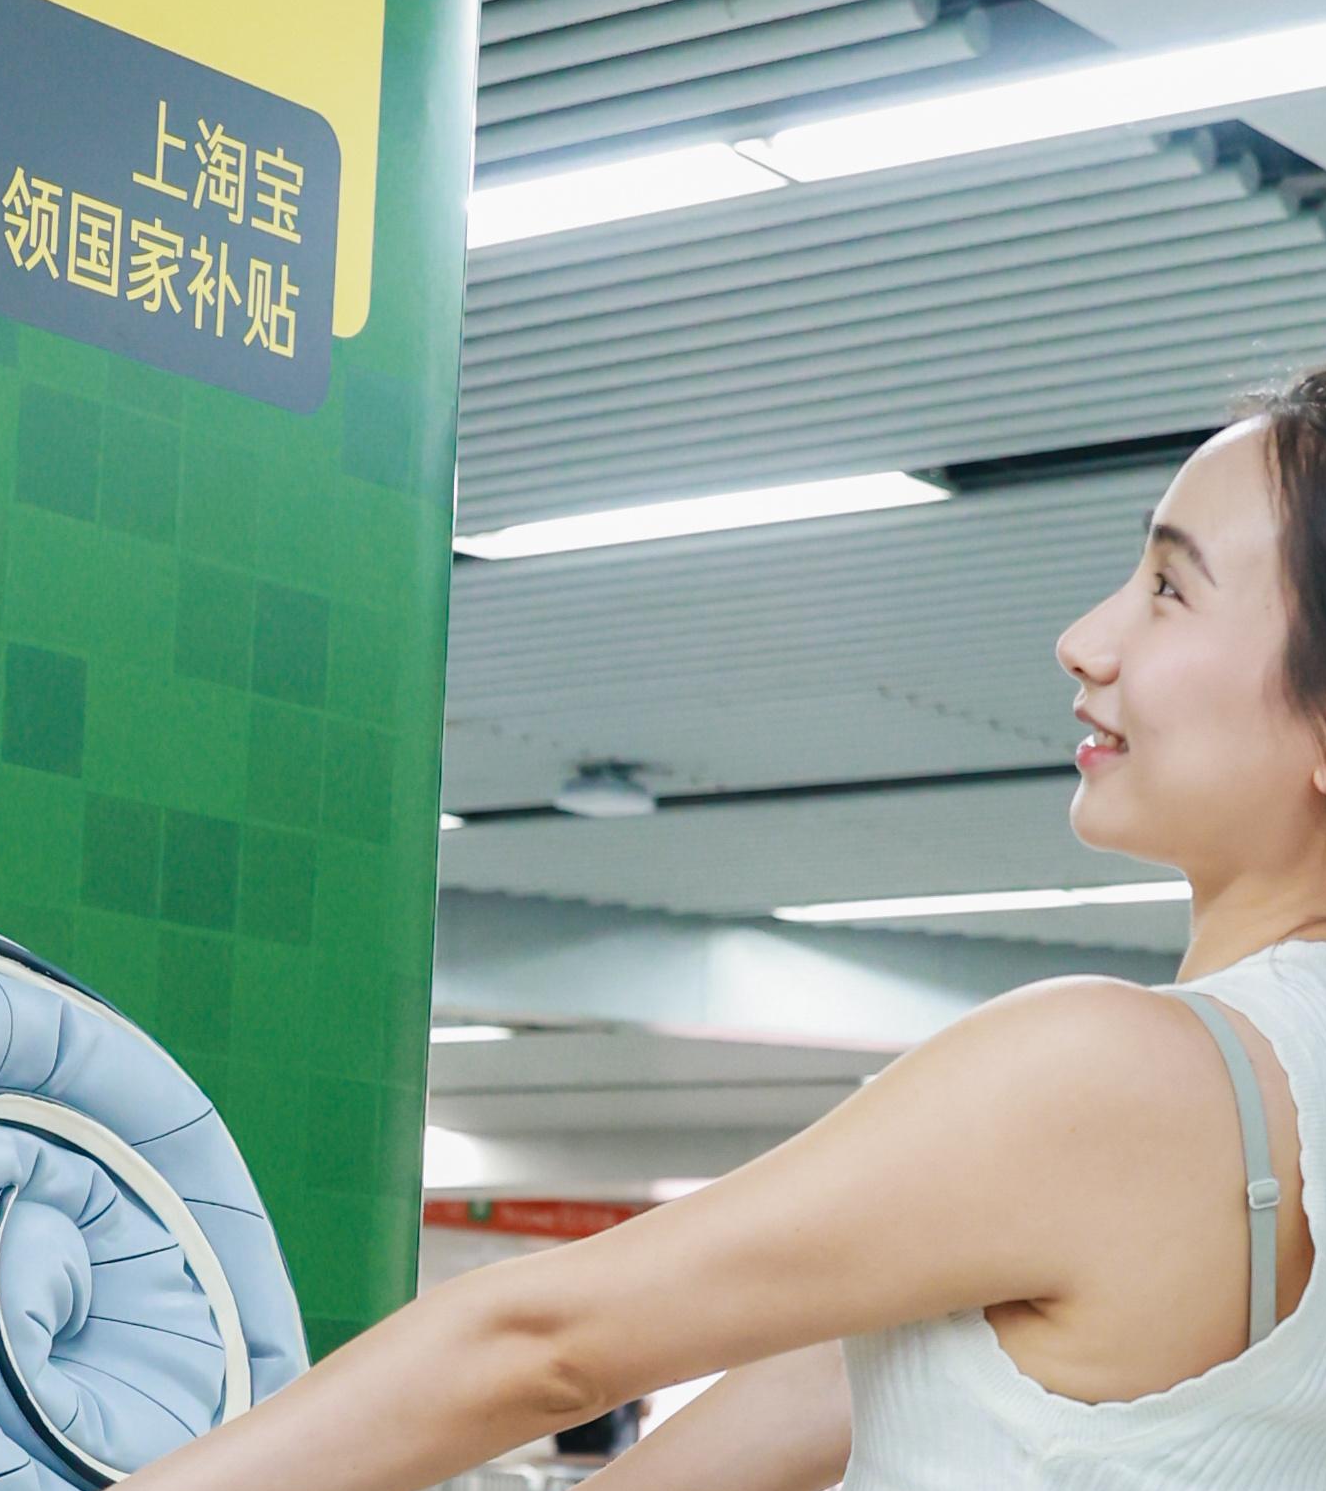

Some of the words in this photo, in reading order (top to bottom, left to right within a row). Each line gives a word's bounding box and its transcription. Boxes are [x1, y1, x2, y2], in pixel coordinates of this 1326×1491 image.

[134, 100, 304, 245] 上淘宝
[2, 168, 300, 360] 领国家补贴
